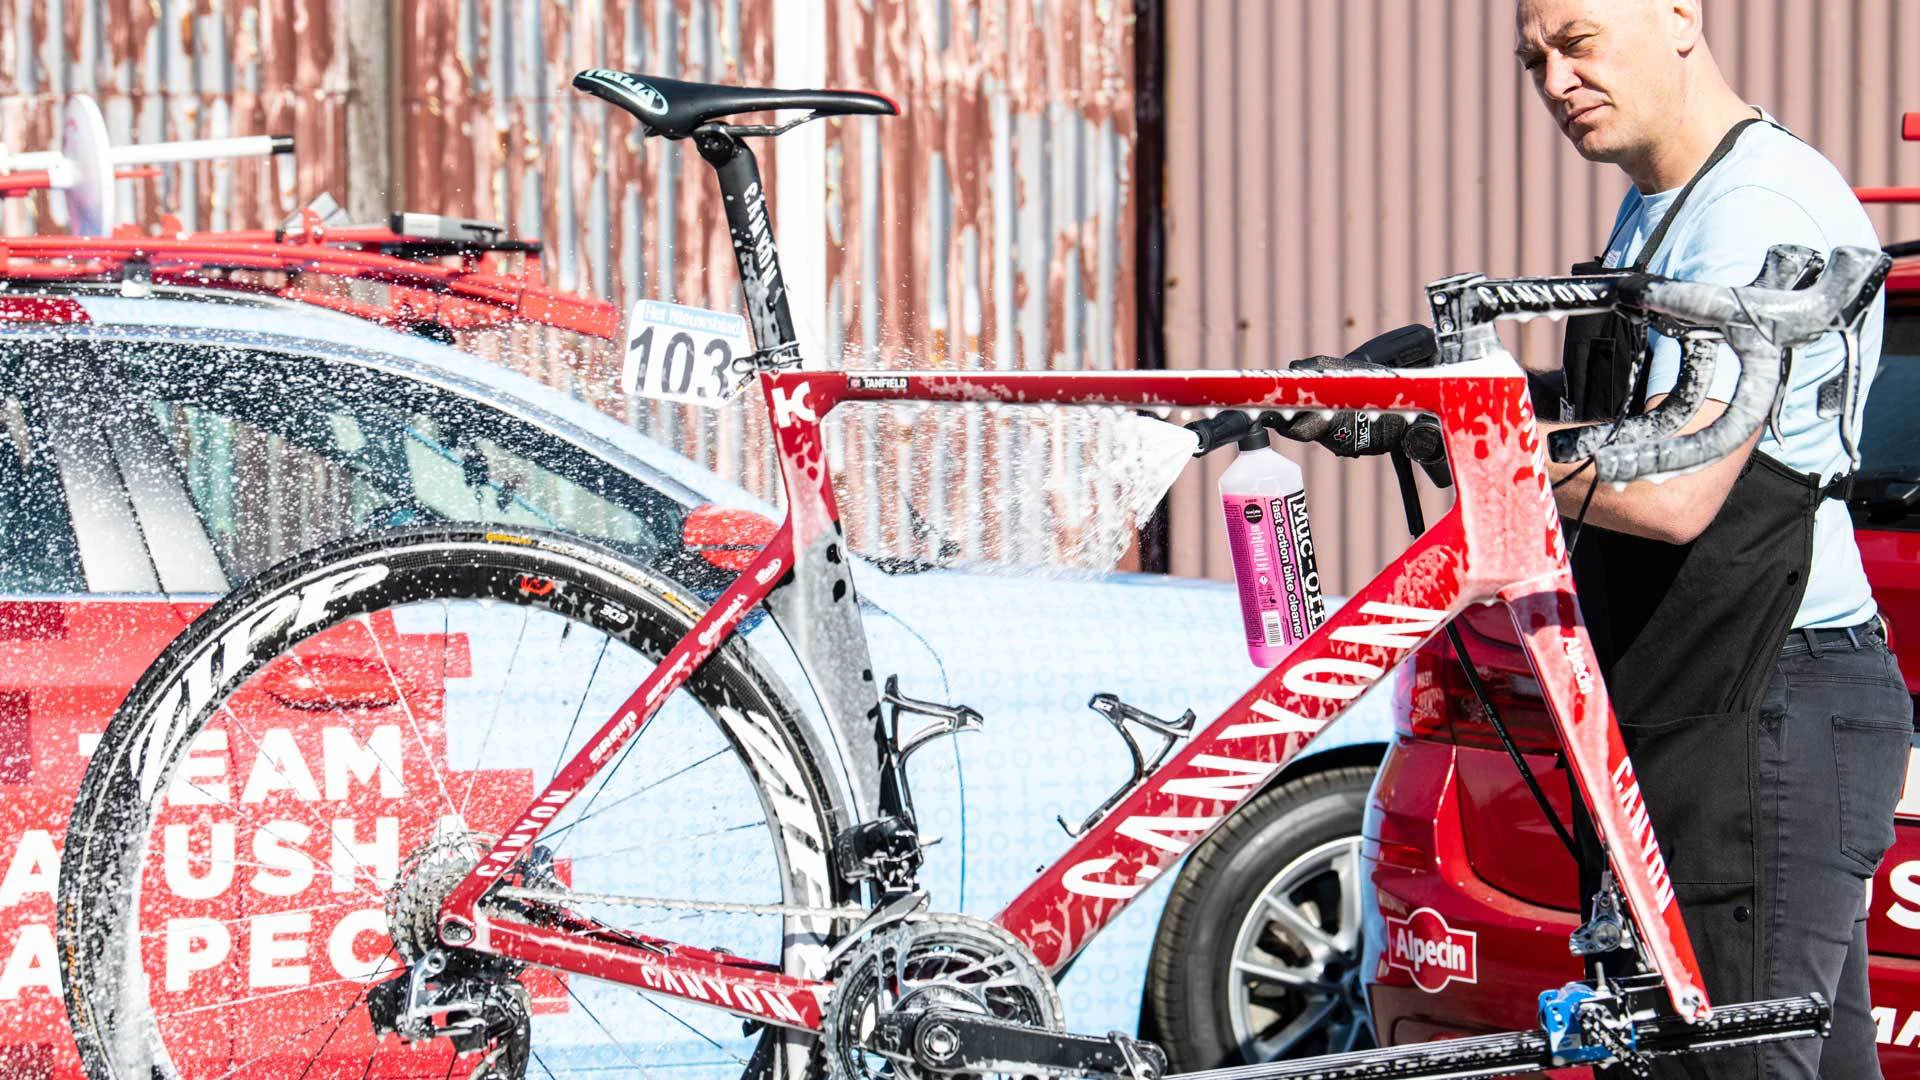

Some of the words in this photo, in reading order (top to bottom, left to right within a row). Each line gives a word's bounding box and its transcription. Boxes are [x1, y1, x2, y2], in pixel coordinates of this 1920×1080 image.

[1477, 284, 1598, 305] CANYON
[630, 326, 732, 398] 103
[864, 377, 908, 389] TANFIELD
[1357, 411, 1369, 449] Muc-O
[1271, 500, 1284, 525] fast
[1275, 526, 1290, 564] action
[1283, 565, 1295, 593] bike
[600, 604, 628, 625] 303
[1287, 594, 1304, 639] cleaner
[129, 564, 390, 802] ZIPP
[1062, 601, 1449, 900] CANYON
[475, 790, 573, 877] CANYON
[1612, 755, 1676, 914] CANYON
[1395, 927, 1466, 972] Alpecin
[641, 965, 802, 1023] CANYON
